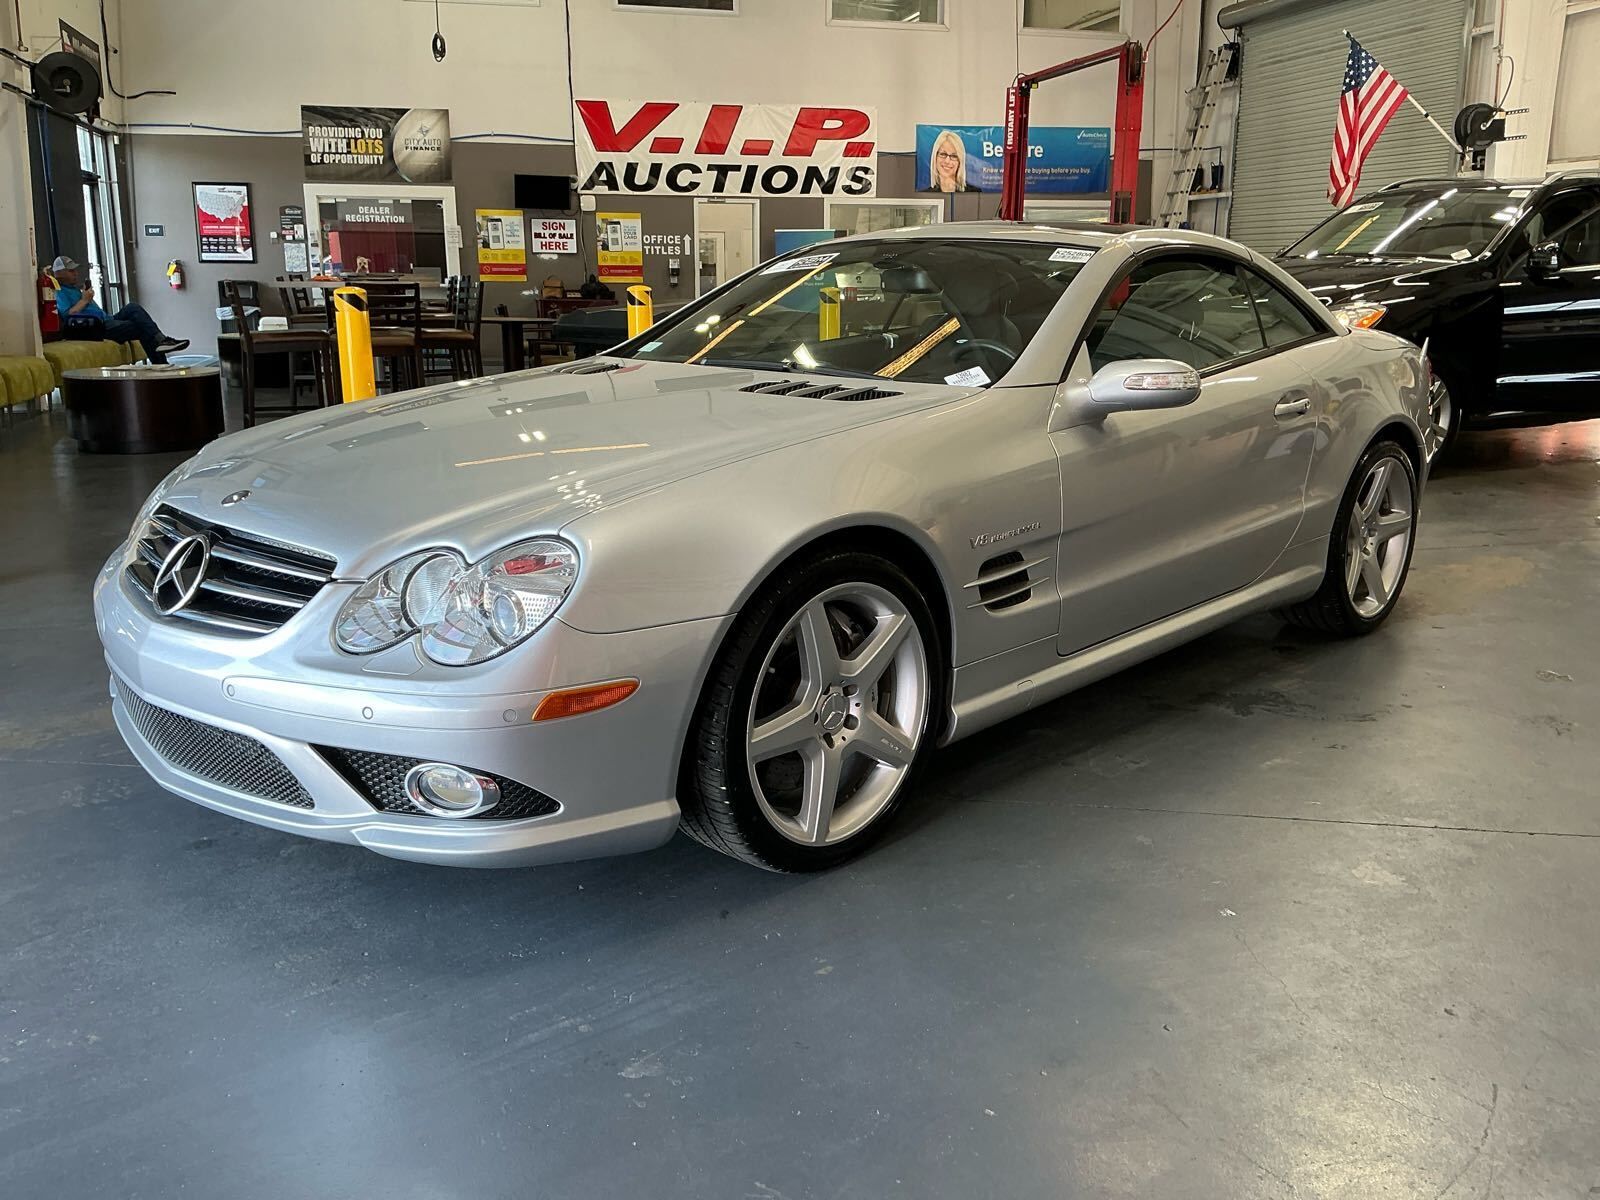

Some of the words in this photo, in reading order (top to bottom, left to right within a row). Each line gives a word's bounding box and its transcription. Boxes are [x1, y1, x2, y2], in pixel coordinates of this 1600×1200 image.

[308, 126, 361, 138] PROVIDING
[364, 128, 383, 139] YOU
[575, 100, 875, 157] V.I.P.
[1007, 109, 1015, 145] ROTARY
[309, 138, 347, 153] WITH
[350, 139, 384, 153] LOTS
[404, 138, 420, 146] CITY
[983, 142, 1043, 158] Bere
[310, 154, 322, 163] OF
[323, 154, 384, 165] OPPORTUNITY
[580, 161, 875, 195] AUCTIONS
[358, 206, 390, 214] DEALER
[345, 214, 405, 223] REGISTRATION
[542, 221, 566, 231] SIGN
[643, 234, 681, 244] OFFICE
[540, 241, 569, 250] HERE
[643, 245, 681, 255] TITLES
[969, 533, 988, 549] V8
